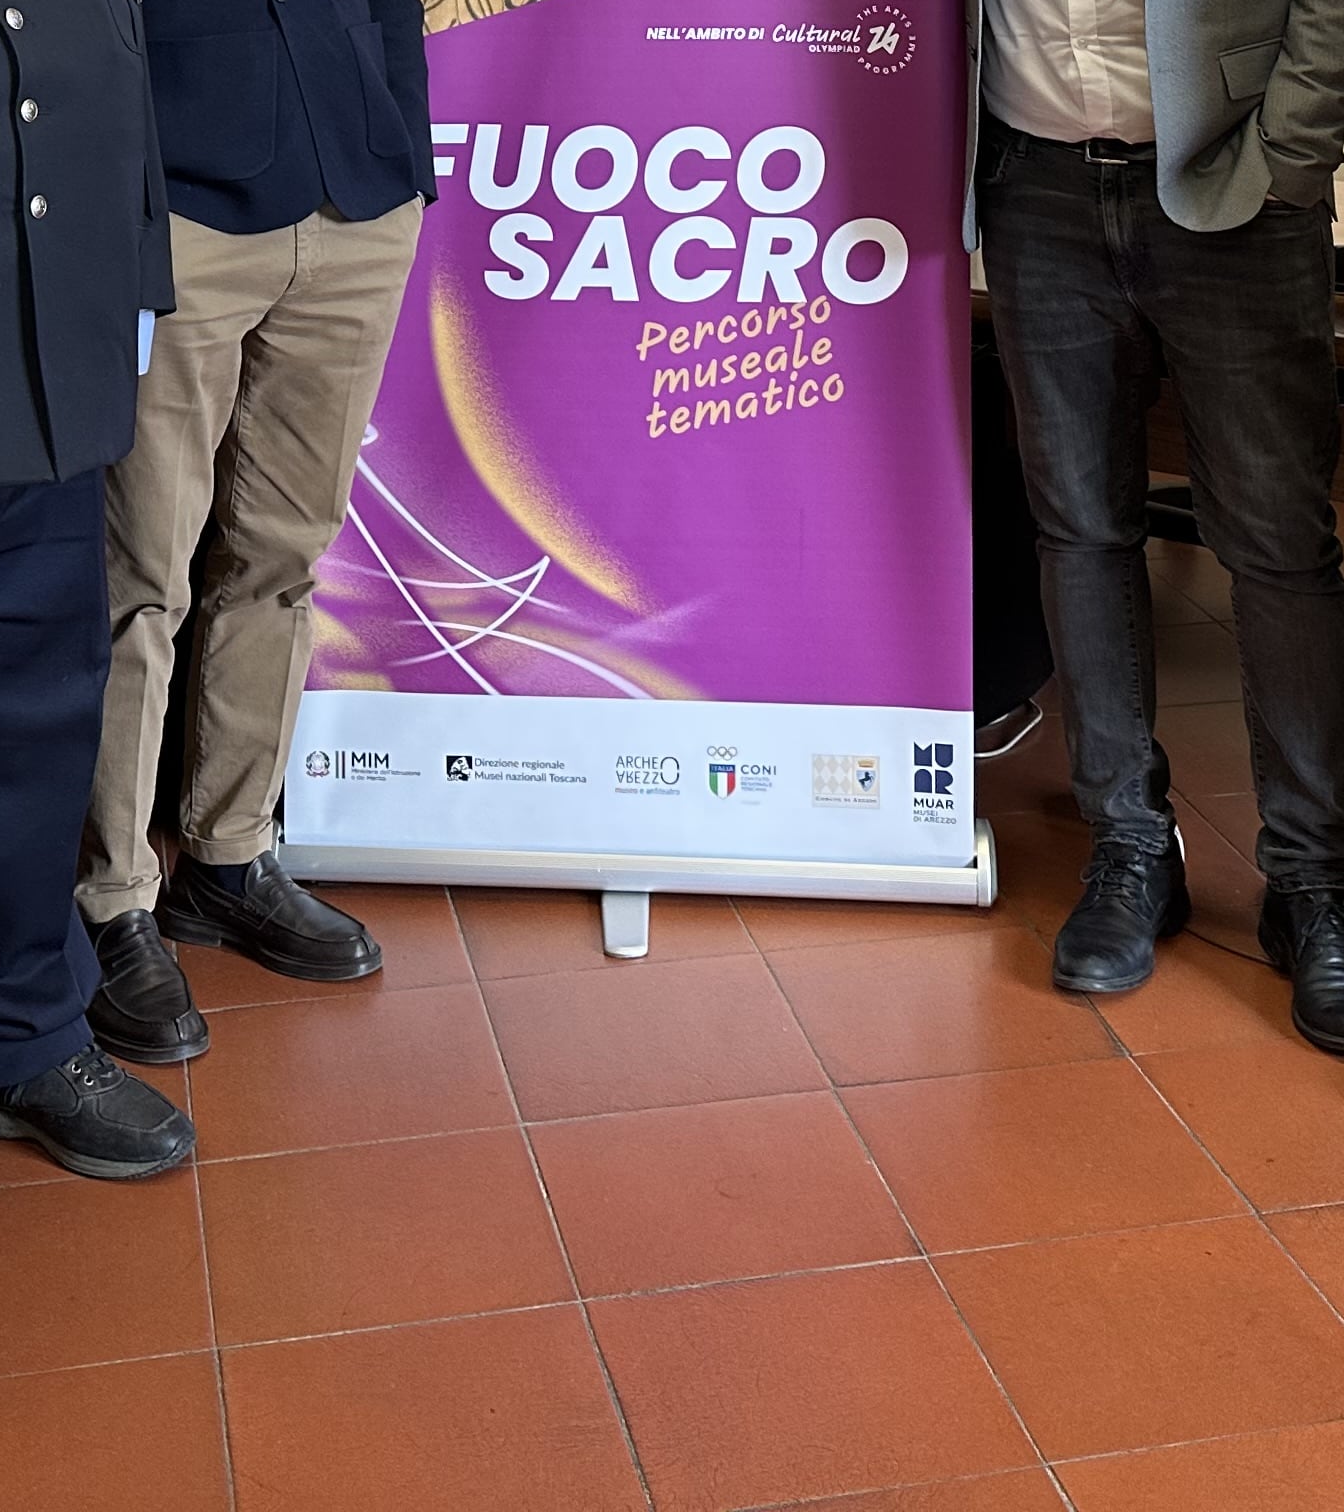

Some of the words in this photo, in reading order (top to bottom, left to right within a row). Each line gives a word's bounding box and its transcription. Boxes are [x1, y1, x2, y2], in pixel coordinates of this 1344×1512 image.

[856, 5, 878, 21] THE
[884, 5, 912, 28] ARTS
[646, 27, 745, 40] NELL'AMBITO
[747, 27, 765, 40] DI
[772, 23, 861, 43] Cultural
[809, 44, 861, 54] OLYMPIAD
[857, 35, 916, 75] PROGRAMME
[430, 123, 826, 214] FUOCO
[483, 213, 910, 305] SACRO
[636, 294, 832, 361] Percorso
[653, 328, 834, 399] museale
[646, 372, 845, 439] tematico
[351, 751, 390, 770] MIM
[474, 757, 520, 768] Direzione
[521, 759, 565, 770] regionale
[740, 764, 777, 776] CONI
[474, 771, 503, 781] Musei
[505, 772, 547, 782] nazionali
[549, 773, 587, 784] Toscana
[913, 798, 955, 810] MUAR
[924, 817, 957, 825] AREZZO
